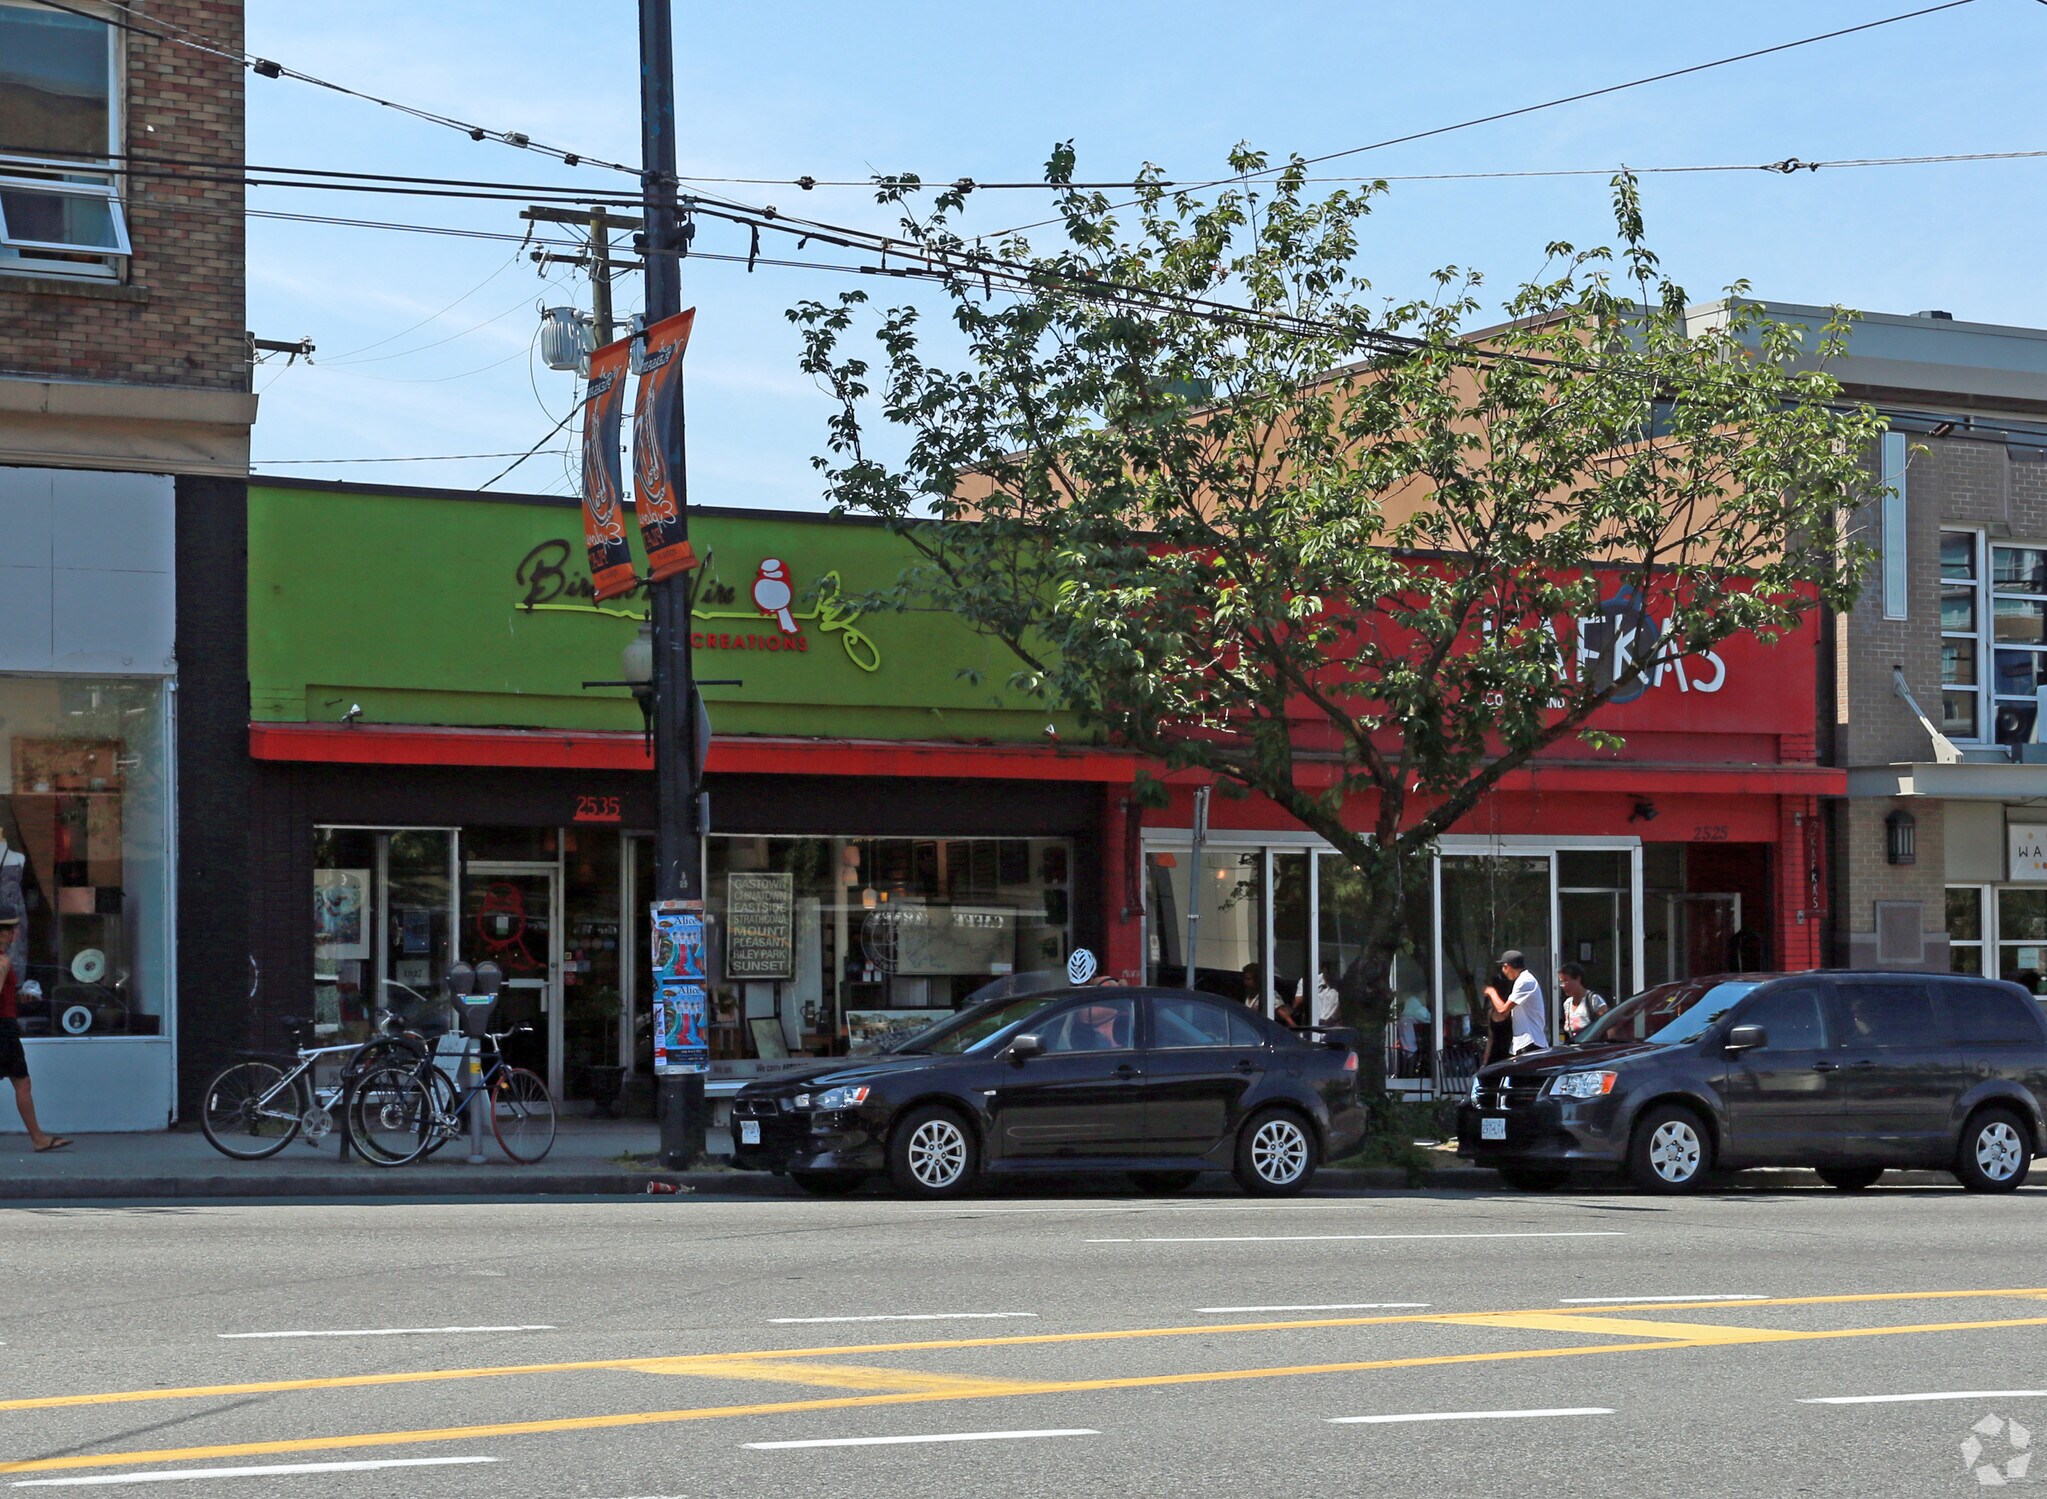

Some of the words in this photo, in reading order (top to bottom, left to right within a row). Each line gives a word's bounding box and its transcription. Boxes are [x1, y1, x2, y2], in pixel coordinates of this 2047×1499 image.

[516, 538, 596, 614] Bir
[690, 632, 808, 652] CREATIONS
[577, 796, 620, 815] 2535
[1693, 826, 1729, 840] 2525
[734, 879, 787, 889] GASTOWN
[734, 891, 787, 901] CHINATOWN
[734, 902, 787, 913] EASTSIDE
[674, 916, 698, 925] Alice
[733, 914, 788, 924] STRATHCONA
[734, 926, 785, 936] MOUNT
[733, 938, 785, 948] PLEASANT
[732, 949, 759, 959] RILEY
[760, 949, 786, 959] PARK
[732, 961, 785, 971] SUNSET
[678, 985, 700, 994] Alice
